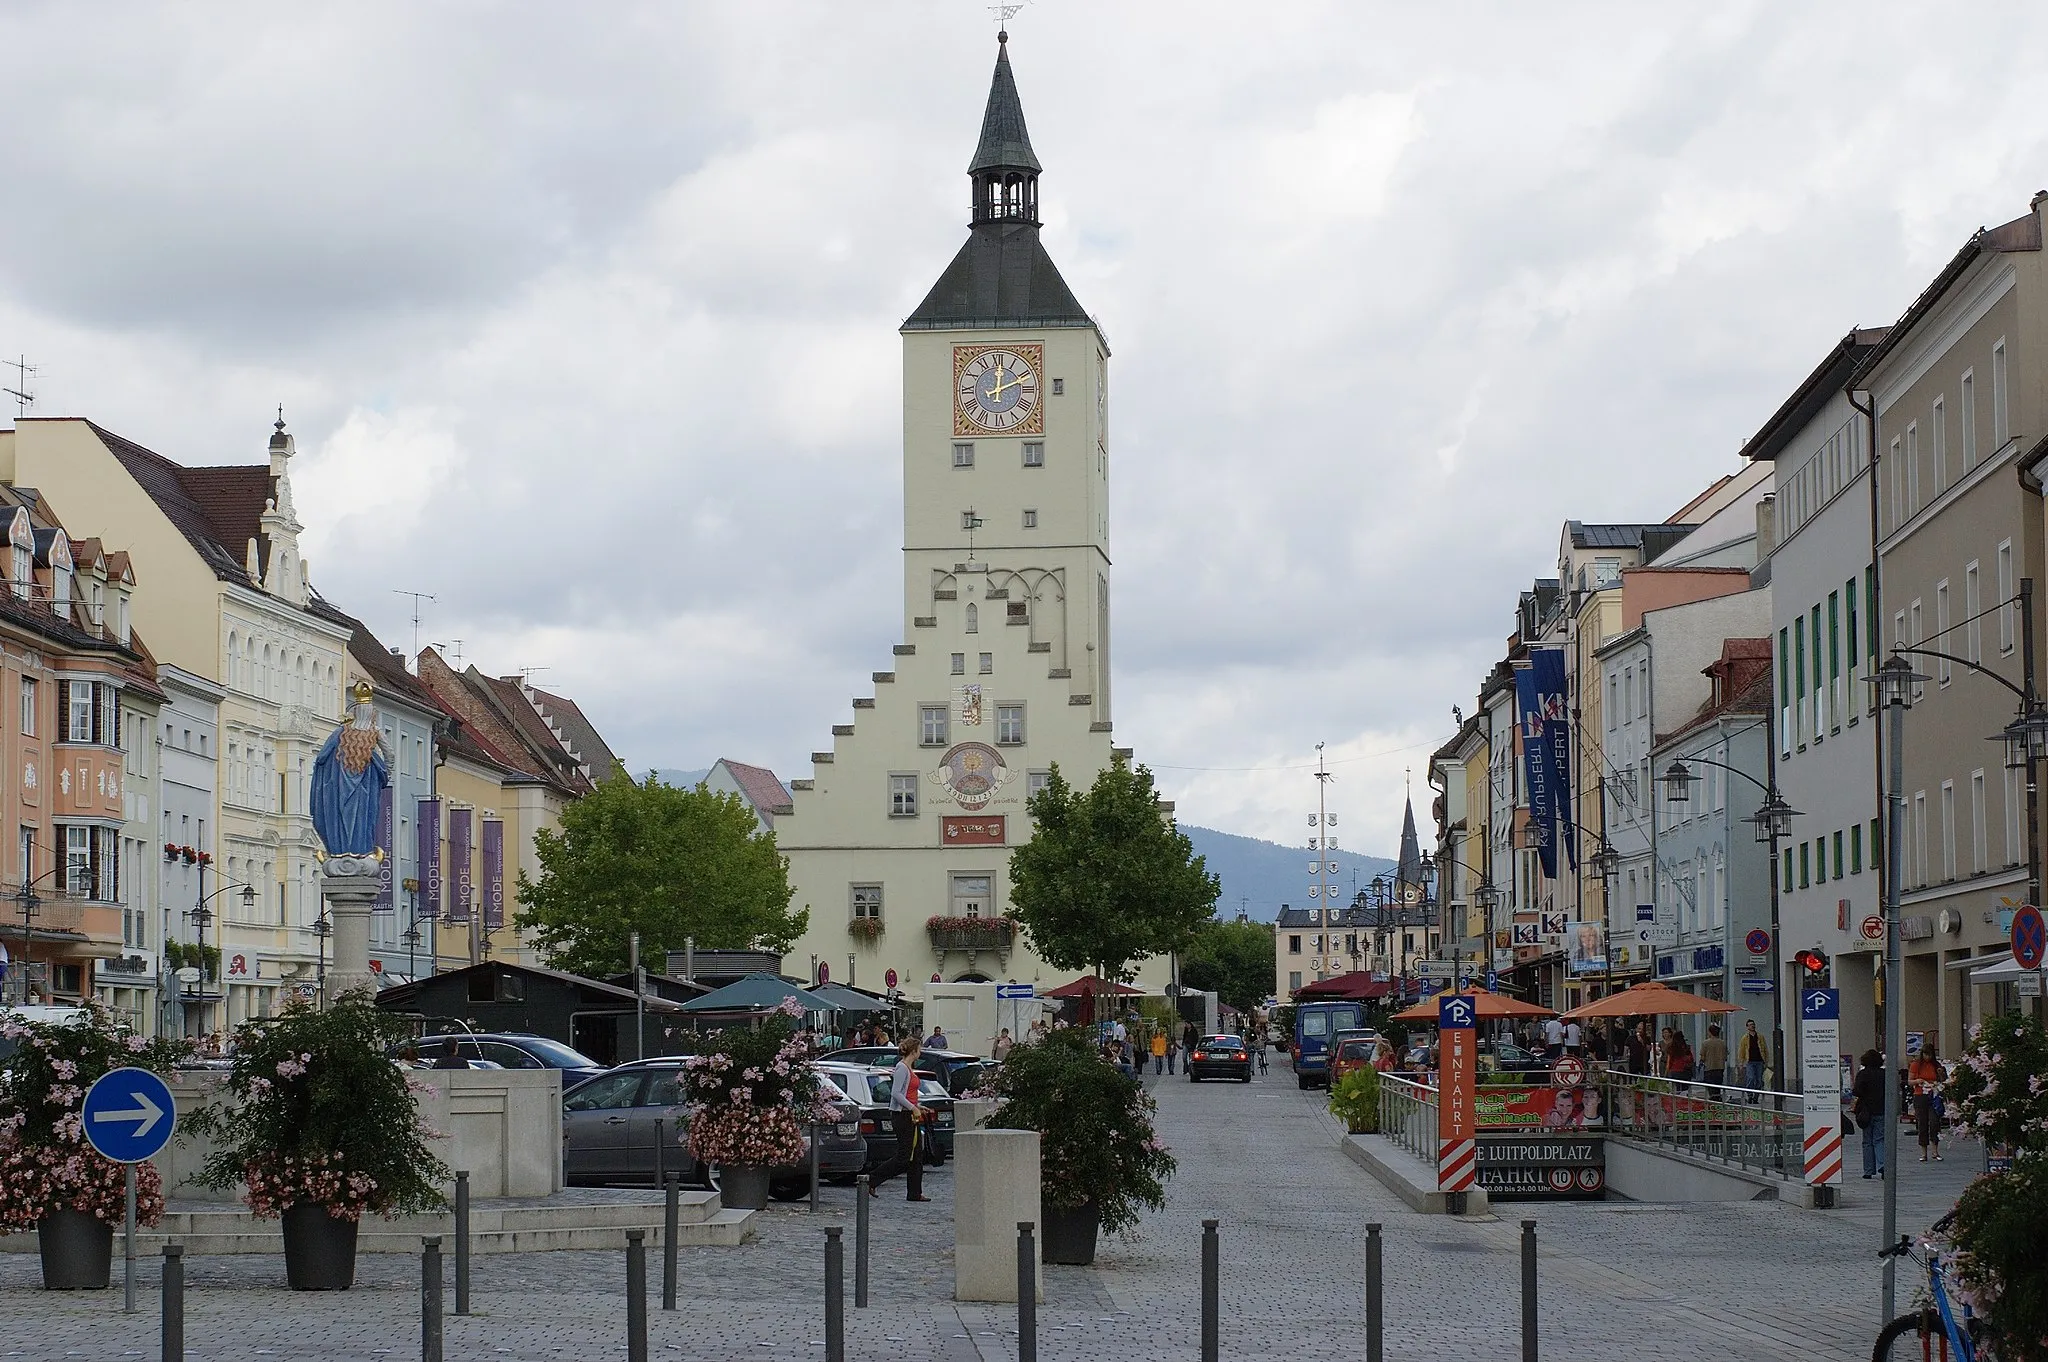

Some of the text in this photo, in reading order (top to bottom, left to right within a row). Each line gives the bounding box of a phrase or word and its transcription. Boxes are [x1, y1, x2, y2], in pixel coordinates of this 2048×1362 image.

[380, 850, 392, 893] MODE
[429, 860, 439, 900] MODE
[460, 868, 470, 906] MODE
[493, 876, 503, 913] MODE
[1814, 997, 1826, 1010] P
[1453, 1006, 1465, 1022] P
[1452, 1032, 1463, 1135] ENFAHRT
[1486, 1094, 1505, 1104] die
[1508, 1093, 1529, 1103] Uhr
[1480, 1113, 1542, 1125] pro Nacht.
[1490, 1146, 1593, 1161] LUITPOLDPLATZ
[1555, 1171, 1569, 1184] 10
